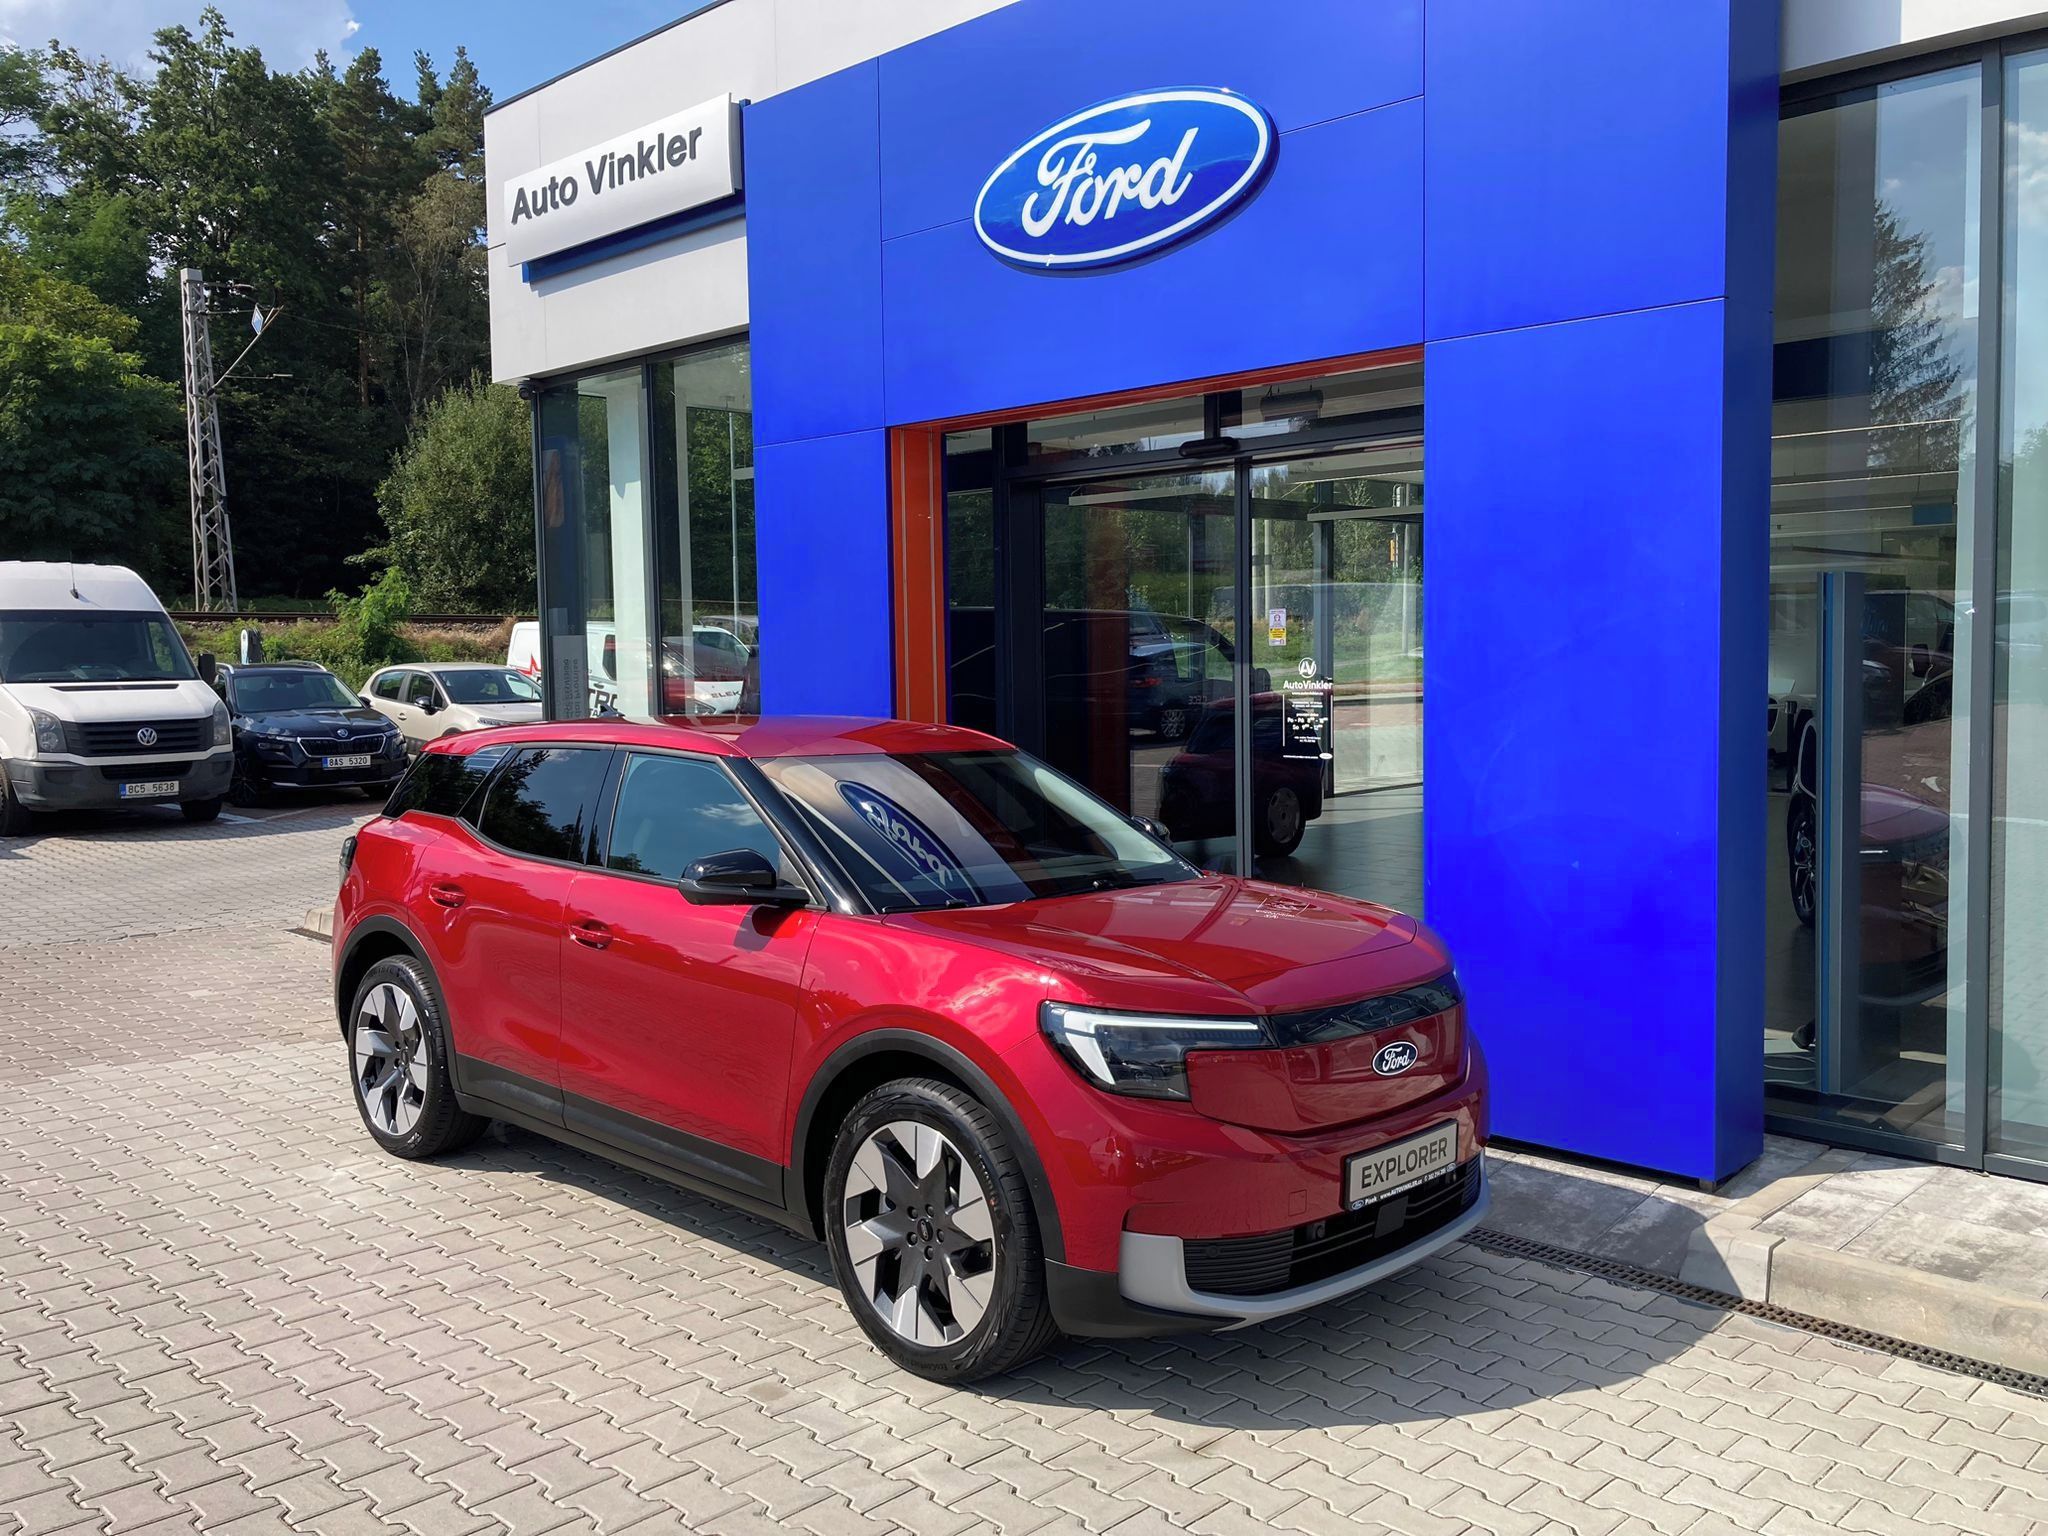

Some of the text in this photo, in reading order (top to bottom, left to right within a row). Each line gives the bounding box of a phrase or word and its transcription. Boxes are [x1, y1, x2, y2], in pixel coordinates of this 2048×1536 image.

[511, 126, 703, 226] Auto Vinkler
[1021, 118, 1199, 238] Ford
[1283, 680, 1333, 690] AutoVinkler
[329, 756, 368, 767] 8AS 5320
[128, 782, 175, 794] 8C5 5638
[1382, 1046, 1410, 1072] Ford
[1361, 1137, 1448, 1189] EXPLORER
